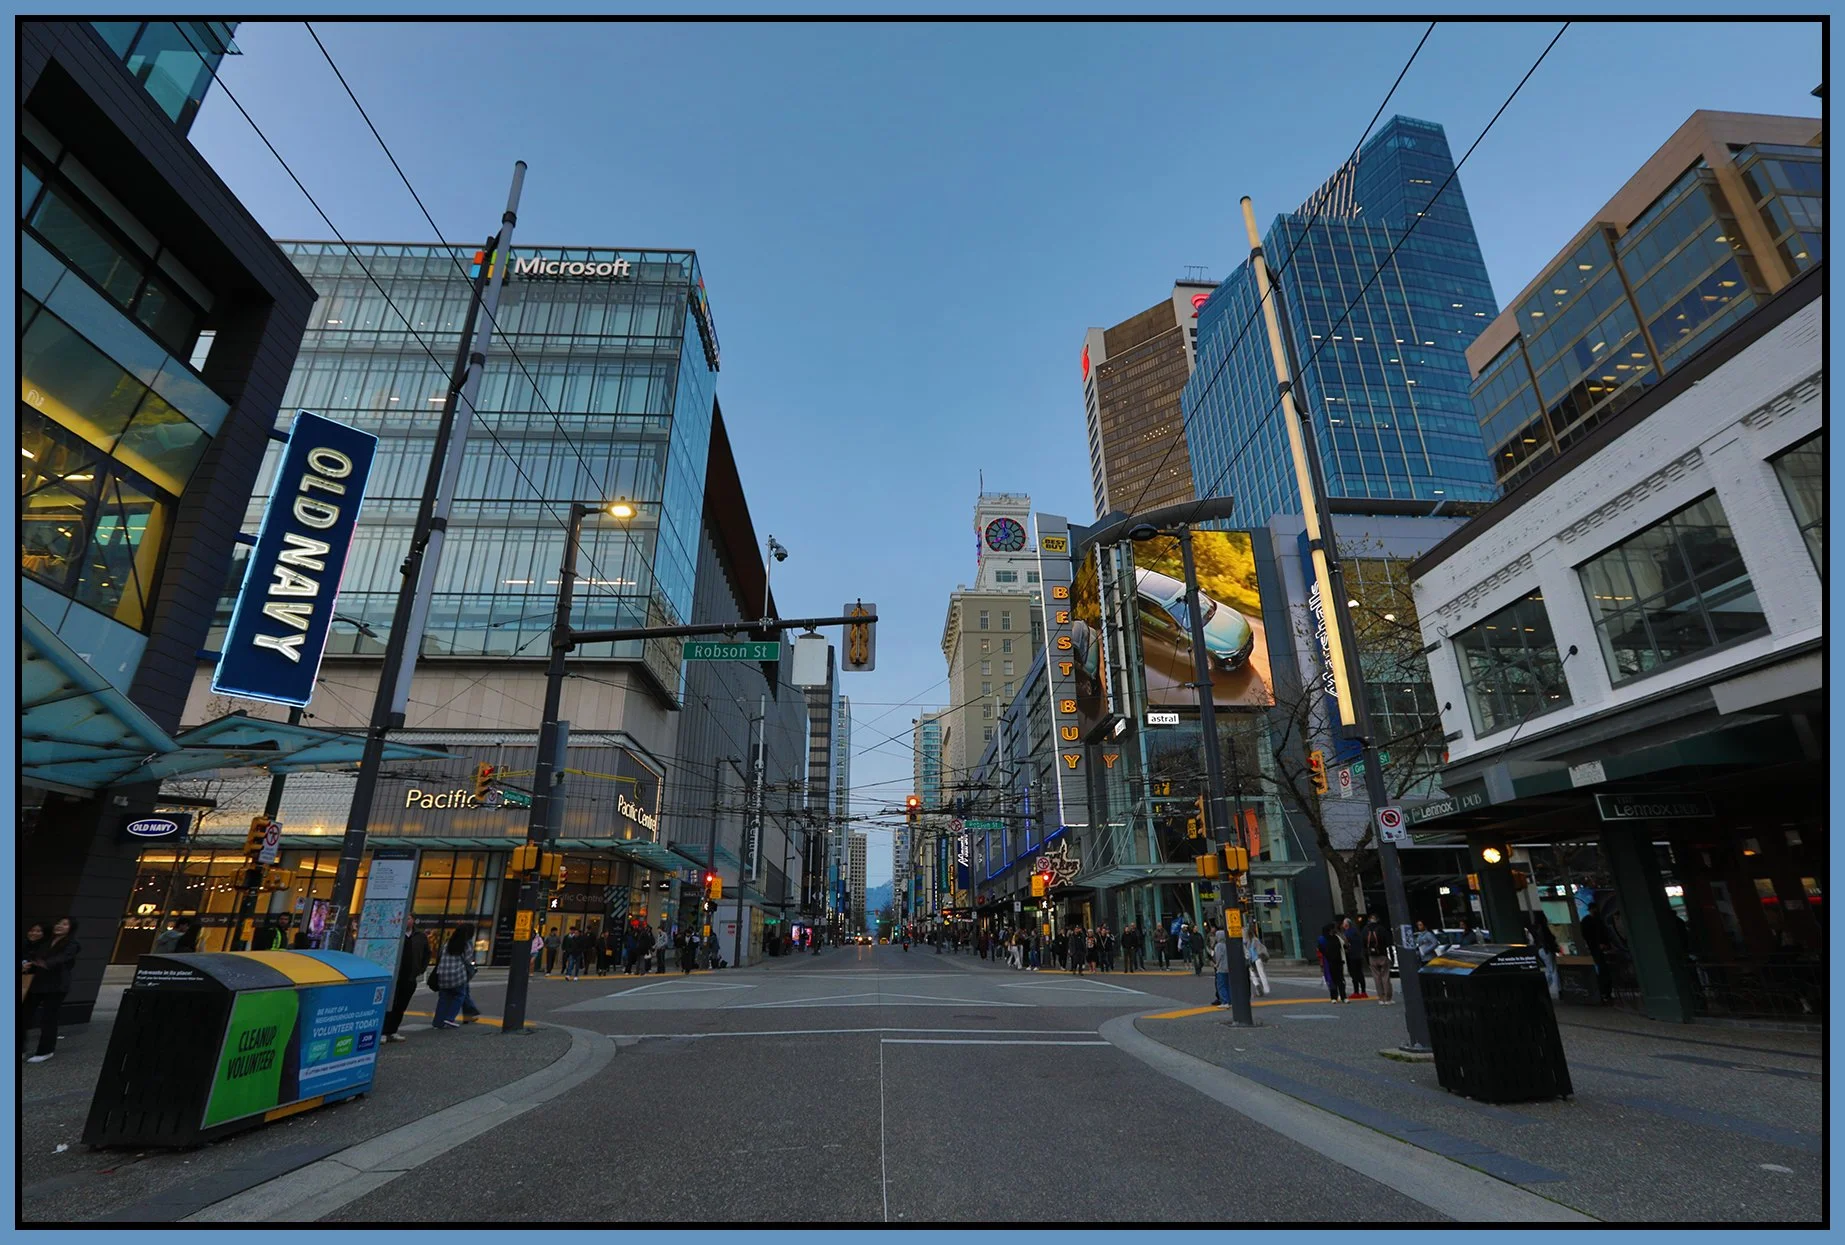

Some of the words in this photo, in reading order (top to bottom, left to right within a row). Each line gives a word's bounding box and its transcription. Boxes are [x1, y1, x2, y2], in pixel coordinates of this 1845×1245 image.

[514, 257, 631, 277] Microsoft
[292, 446, 353, 530] OLD
[1044, 539, 1066, 548] BEST
[1045, 543, 1064, 551] BUY
[252, 532, 330, 663] NAVY
[694, 645, 748, 658] Robson
[753, 645, 768, 658] St
[1151, 715, 1177, 723] astral
[617, 794, 638, 822] Pacific
[1420, 802, 1453, 818] Lennox
[1614, 804, 1672, 817] Lennox
[132, 823, 150, 832] OLD
[150, 823, 172, 832] NAVY
[316, 1007, 325, 1016] BE
[325, 1006, 338, 1015] PART
[313, 1021, 354, 1038] VOLUNTEER
[355, 1018, 379, 1030] TODAY!
[238, 1025, 278, 1052] CLEANUP
[226, 1049, 276, 1081] VOLUNTEER
